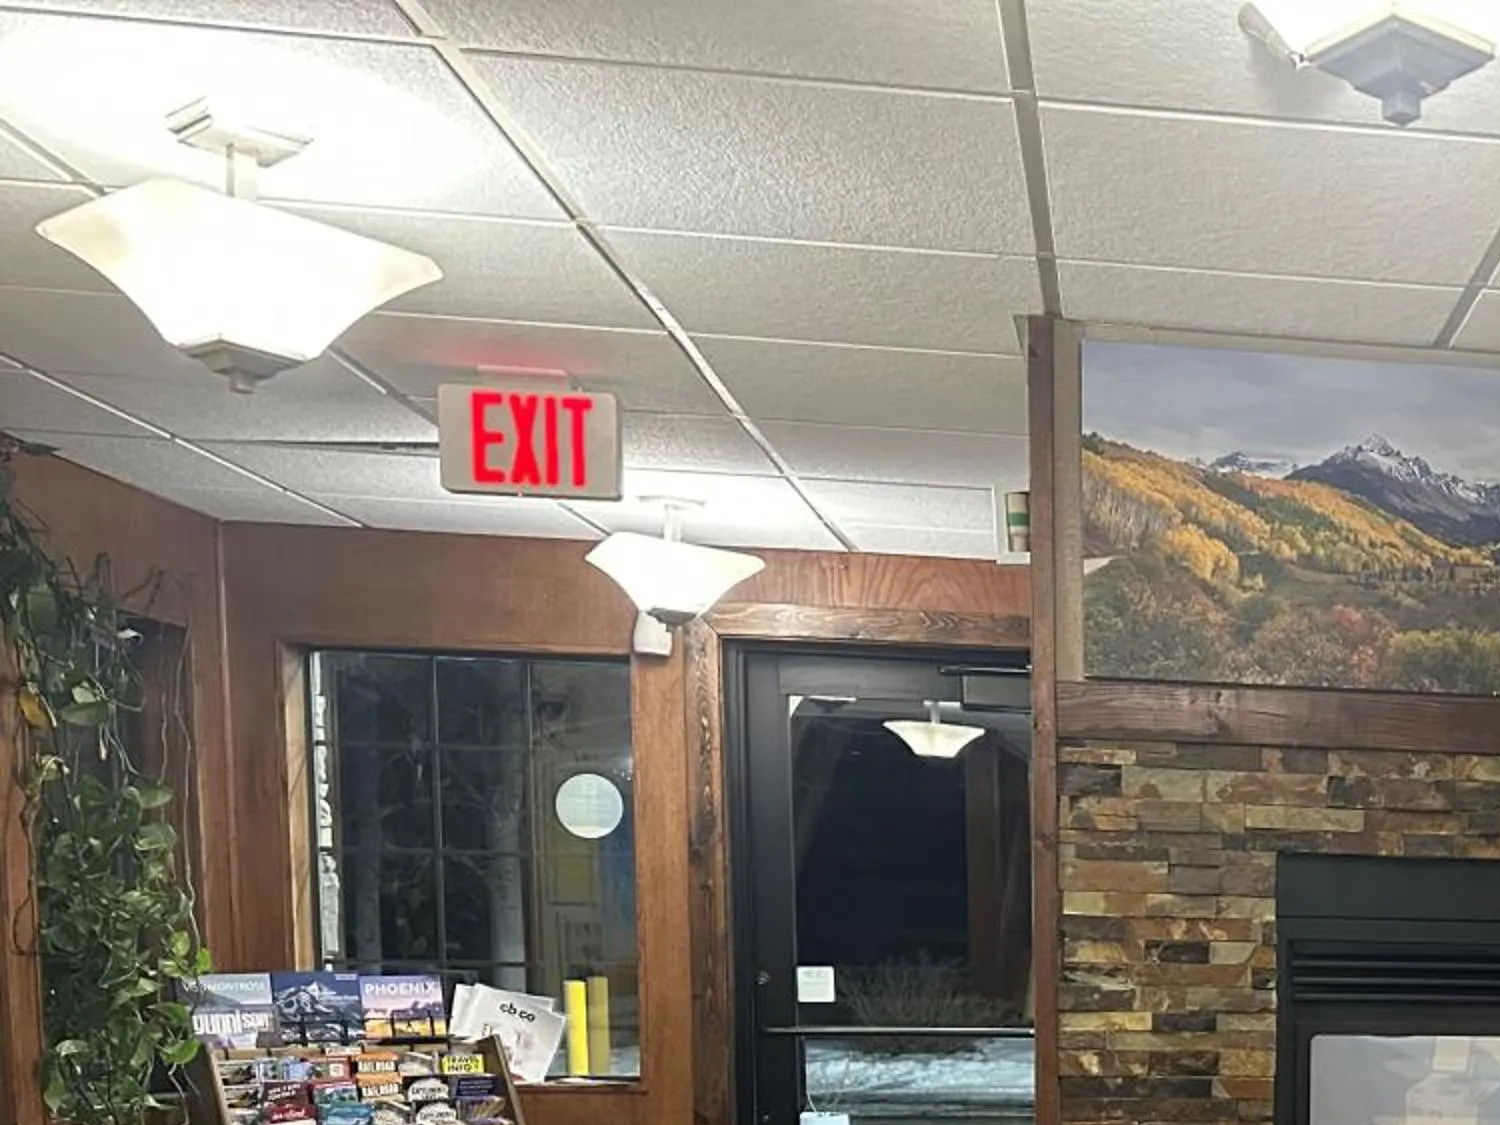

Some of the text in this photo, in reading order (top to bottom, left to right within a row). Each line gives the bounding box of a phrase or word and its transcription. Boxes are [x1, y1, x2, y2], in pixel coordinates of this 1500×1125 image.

[471, 391, 593, 488] EXIT
[365, 982, 436, 995] PHOENIX
[499, 1002, 517, 1015] cb
